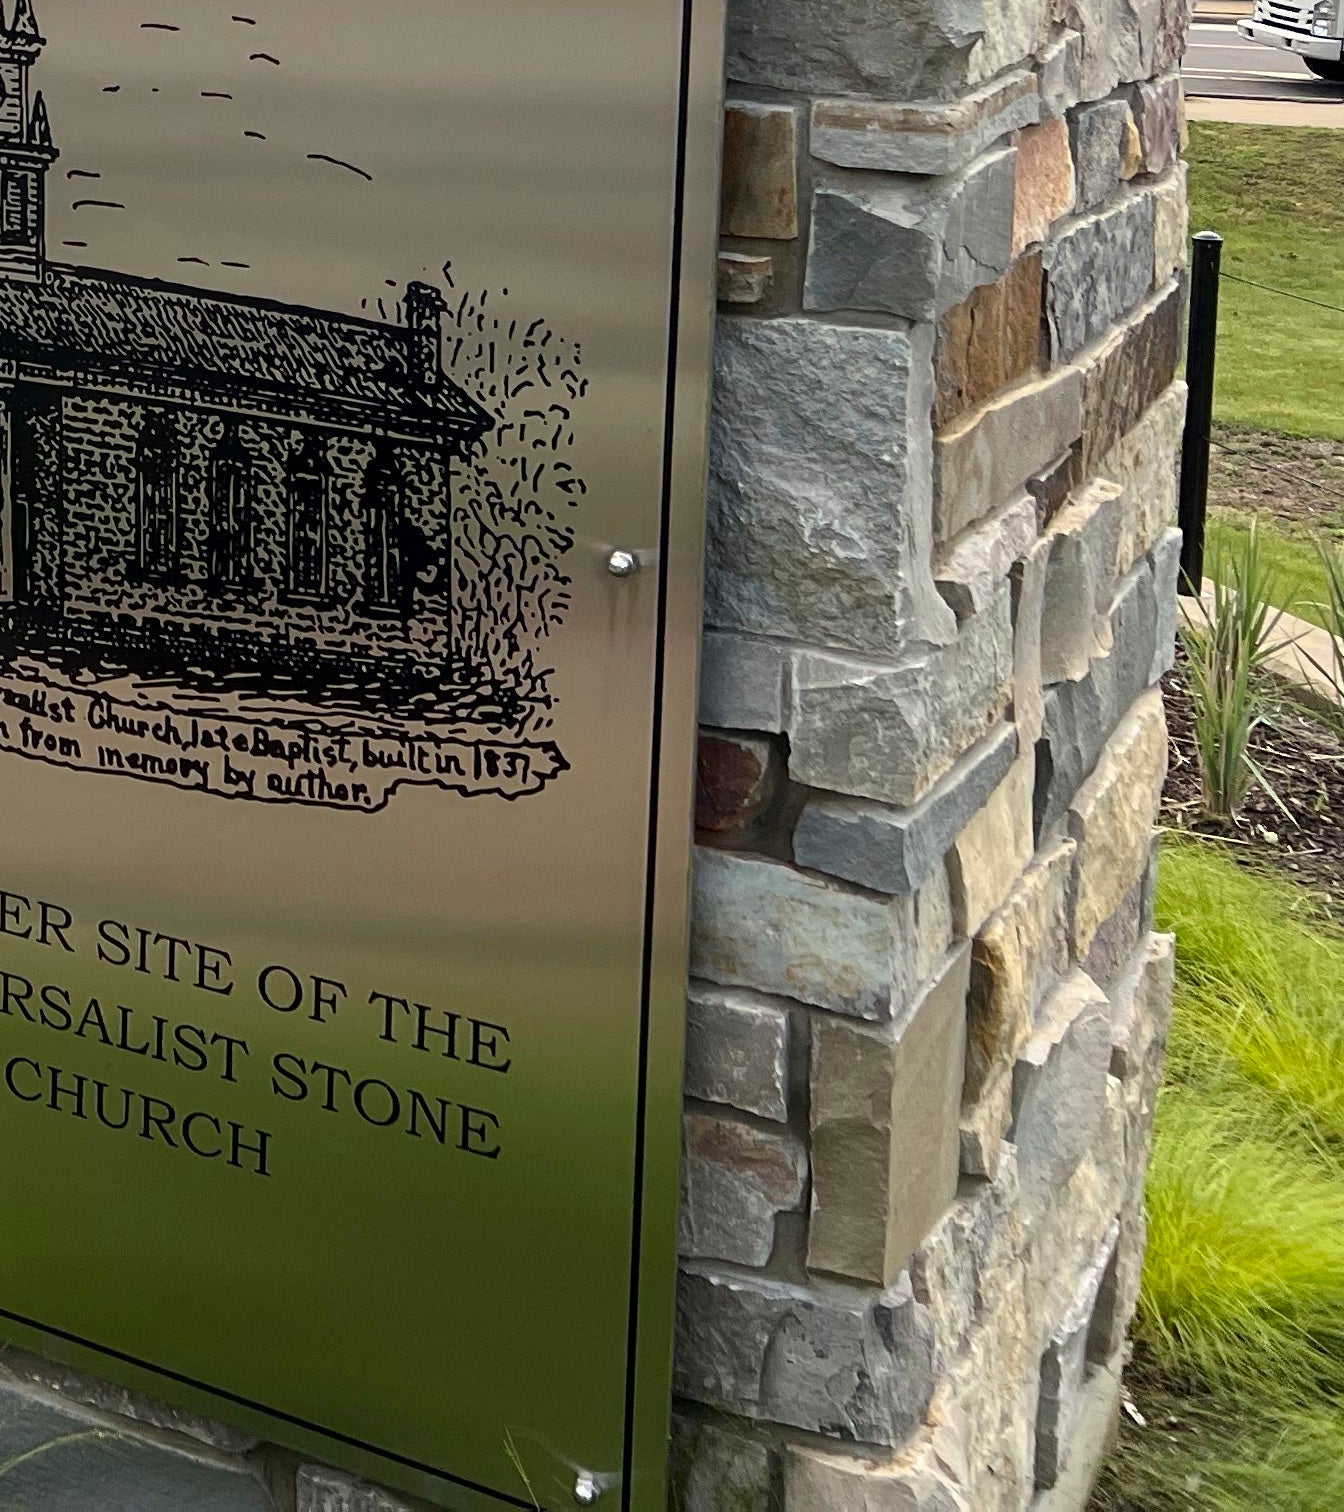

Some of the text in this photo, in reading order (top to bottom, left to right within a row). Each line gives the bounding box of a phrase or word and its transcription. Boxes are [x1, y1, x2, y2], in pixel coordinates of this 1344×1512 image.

[19, 717, 82, 759] from
[97, 745, 210, 789] memory
[224, 755, 256, 795] by
[266, 767, 372, 805] author.
[87, 697, 189, 751] Church,
[362, 739, 428, 771] built
[434, 751, 465, 776] in
[473, 742, 532, 784] 1837
[95, 919, 235, 996] SITE
[257, 964, 349, 1026] OF
[368, 991, 512, 1075] THE
[4, 1057, 273, 1177] CHURCH
[271, 1052, 502, 1161] STONE
